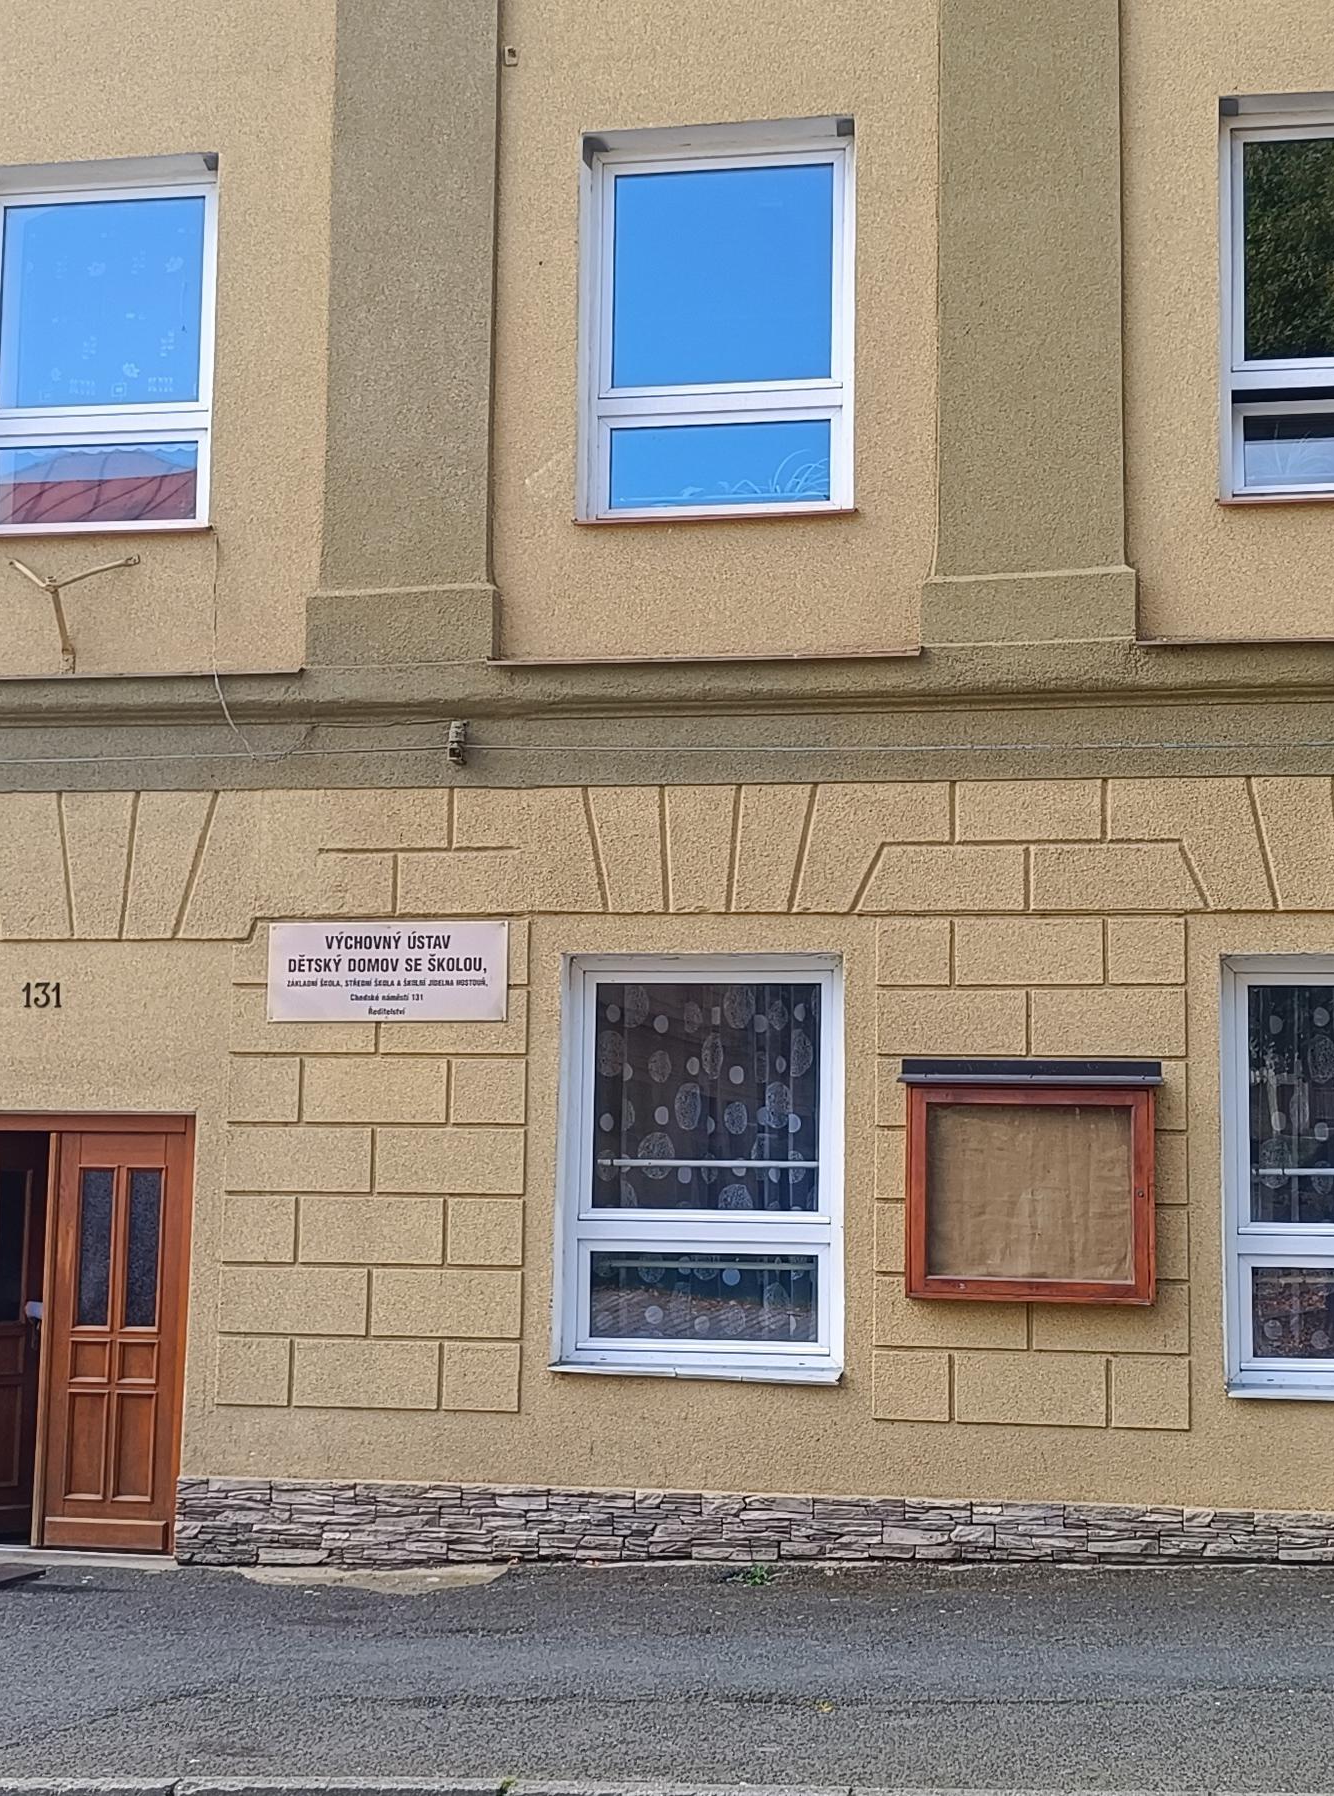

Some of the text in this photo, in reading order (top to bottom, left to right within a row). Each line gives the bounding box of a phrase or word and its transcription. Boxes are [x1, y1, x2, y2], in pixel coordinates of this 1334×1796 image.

[325, 931, 451, 950] VÝCHOVNÝ ÚSTAV
[288, 954, 487, 974] DĚTSKÝ DOMOV SE ŠKOLOU,
[287, 978, 318, 987] ZÁKLADNÍ
[345, 978, 372, 987] STŘEDNÍ
[22, 981, 62, 1008] 131
[411, 993, 424, 1001] 131
